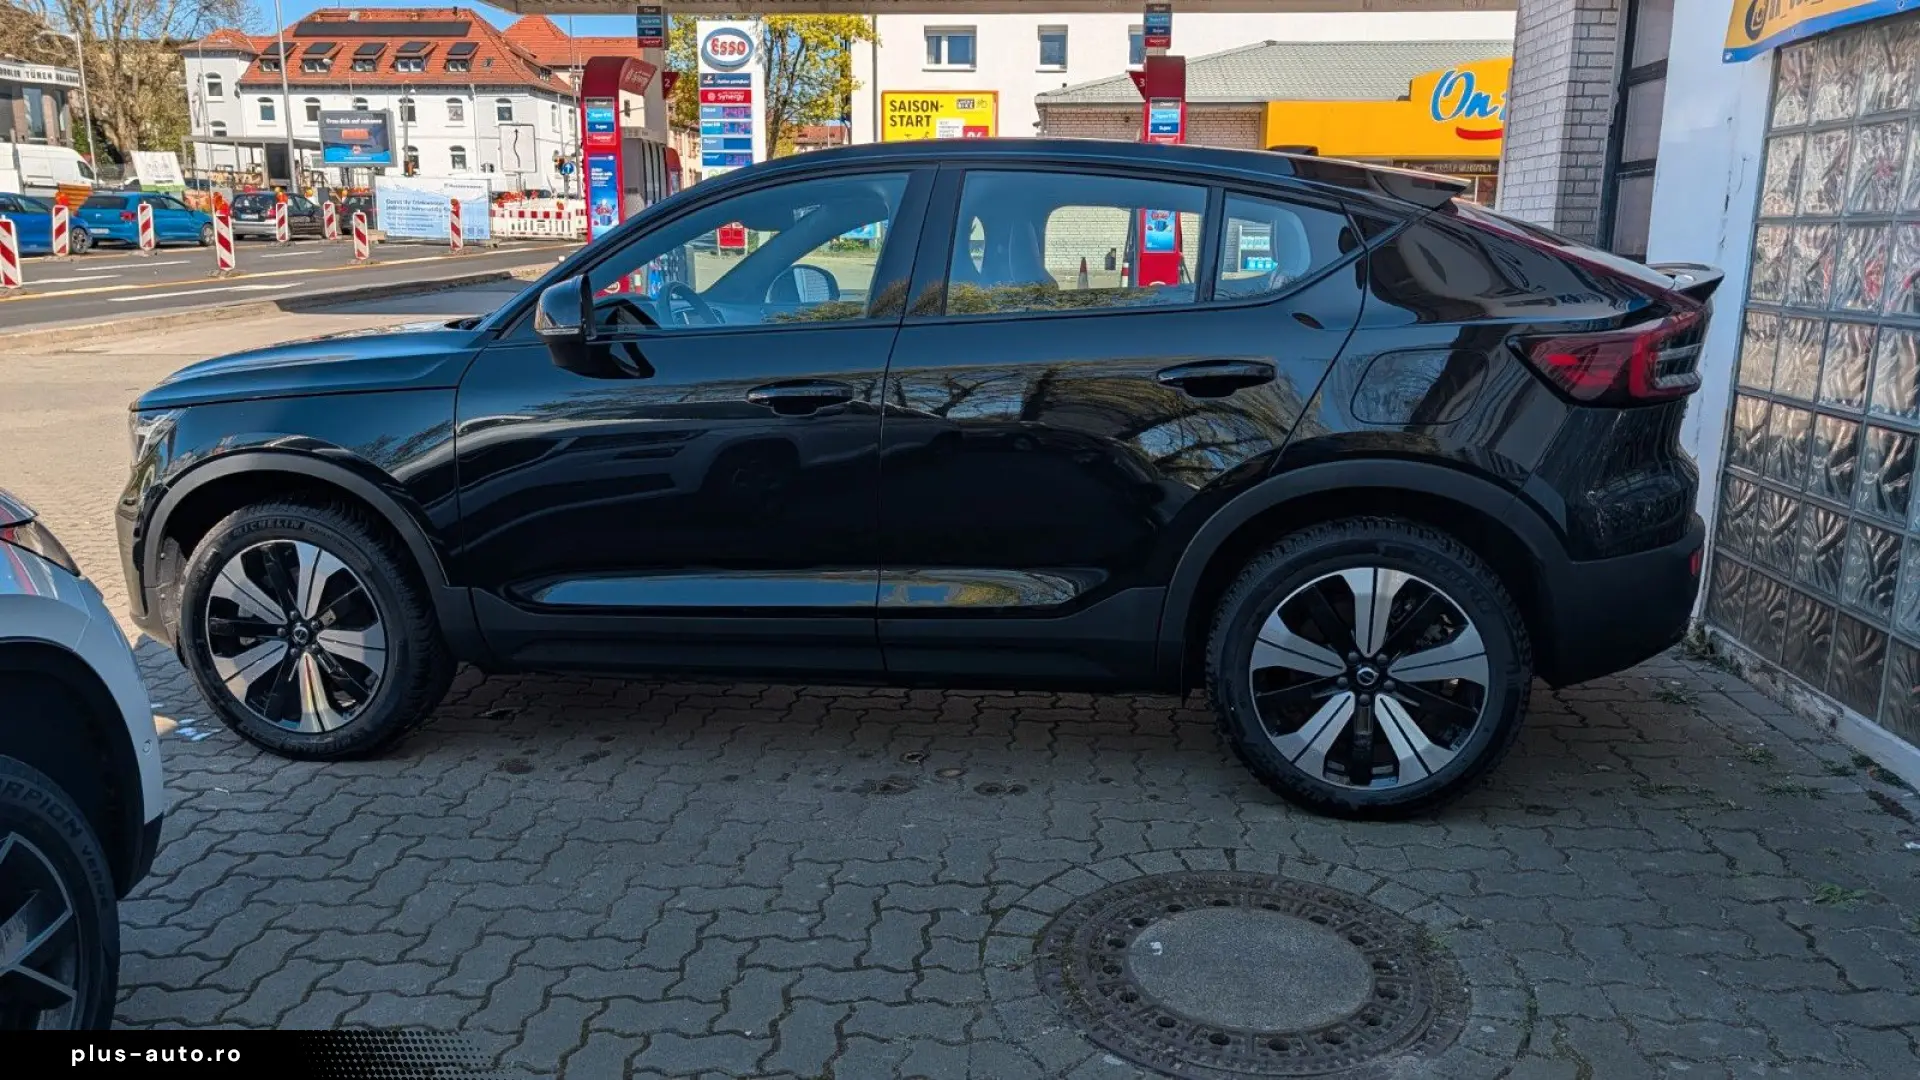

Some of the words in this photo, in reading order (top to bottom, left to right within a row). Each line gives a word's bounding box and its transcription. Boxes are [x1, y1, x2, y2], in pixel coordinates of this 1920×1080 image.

[711, 37, 746, 55] Esso
[664, 78, 671, 87] 2
[1139, 78, 1146, 87] 3
[717, 92, 745, 102] Synergy
[889, 100, 944, 112] SAISON-
[889, 115, 931, 127] START
[233, 519, 304, 536] MICHELIN
